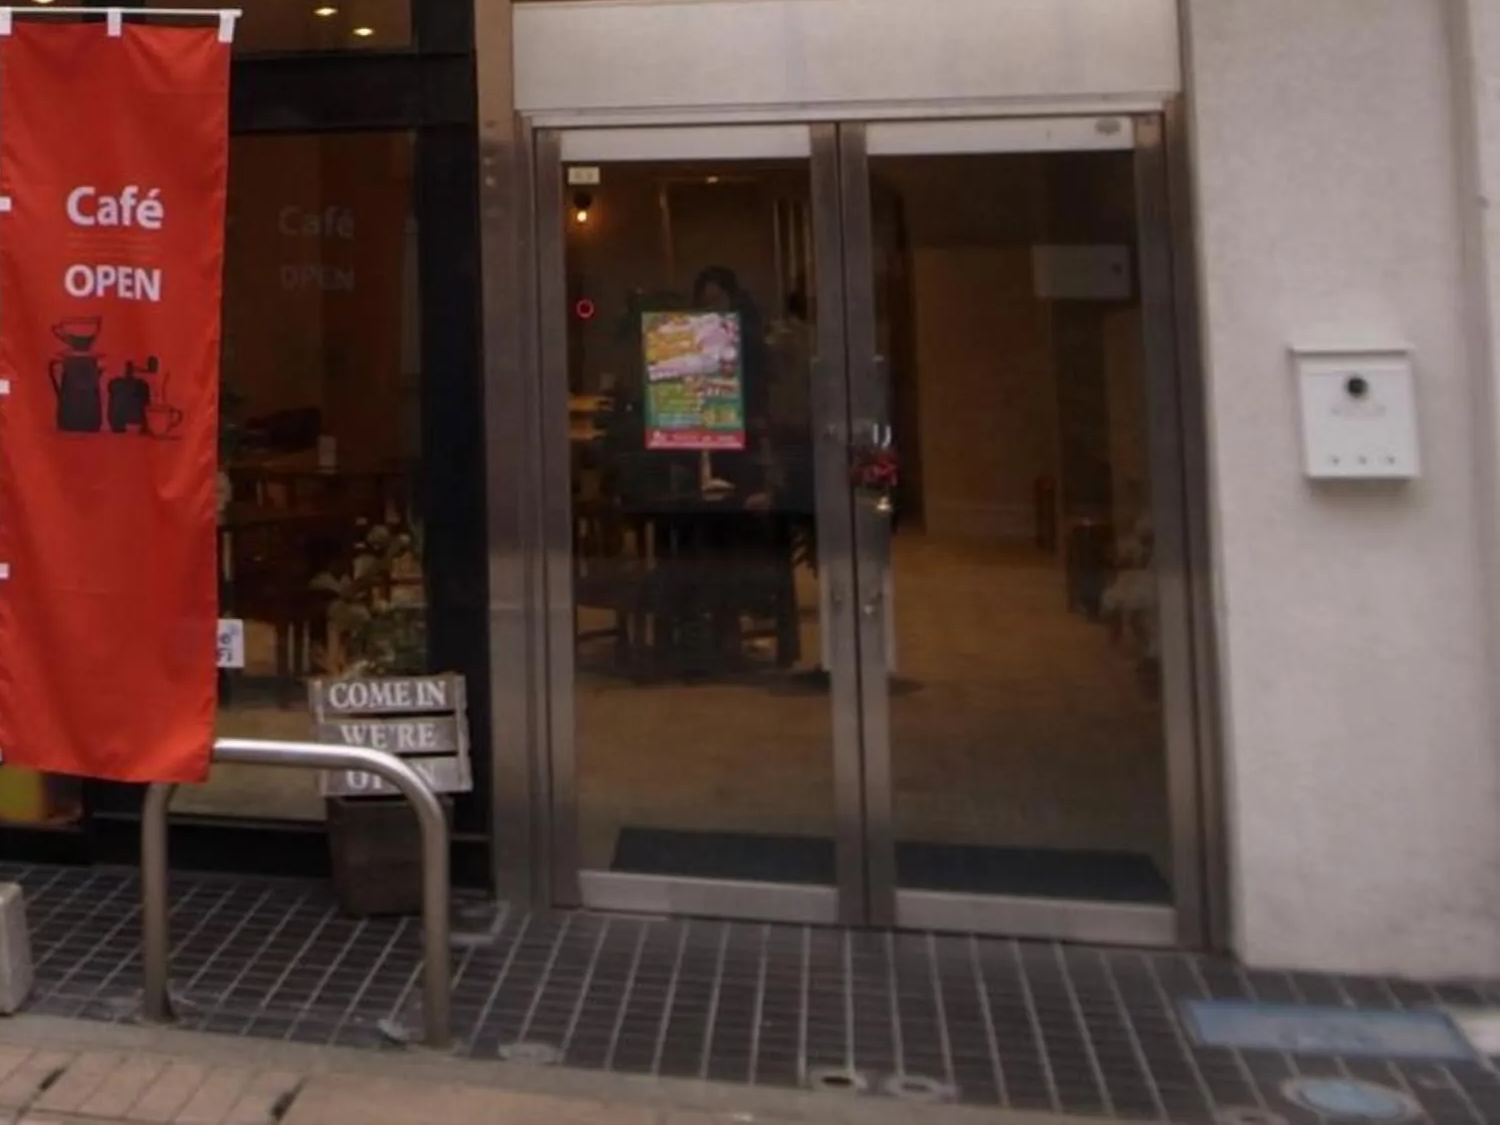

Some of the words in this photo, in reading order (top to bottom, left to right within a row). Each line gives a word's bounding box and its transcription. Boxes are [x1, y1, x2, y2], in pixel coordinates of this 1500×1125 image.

[66, 185, 164, 229] Café
[64, 264, 162, 302] OPEN
[329, 680, 410, 709] COME
[416, 680, 446, 707] IN
[340, 722, 437, 749] WE'RE
